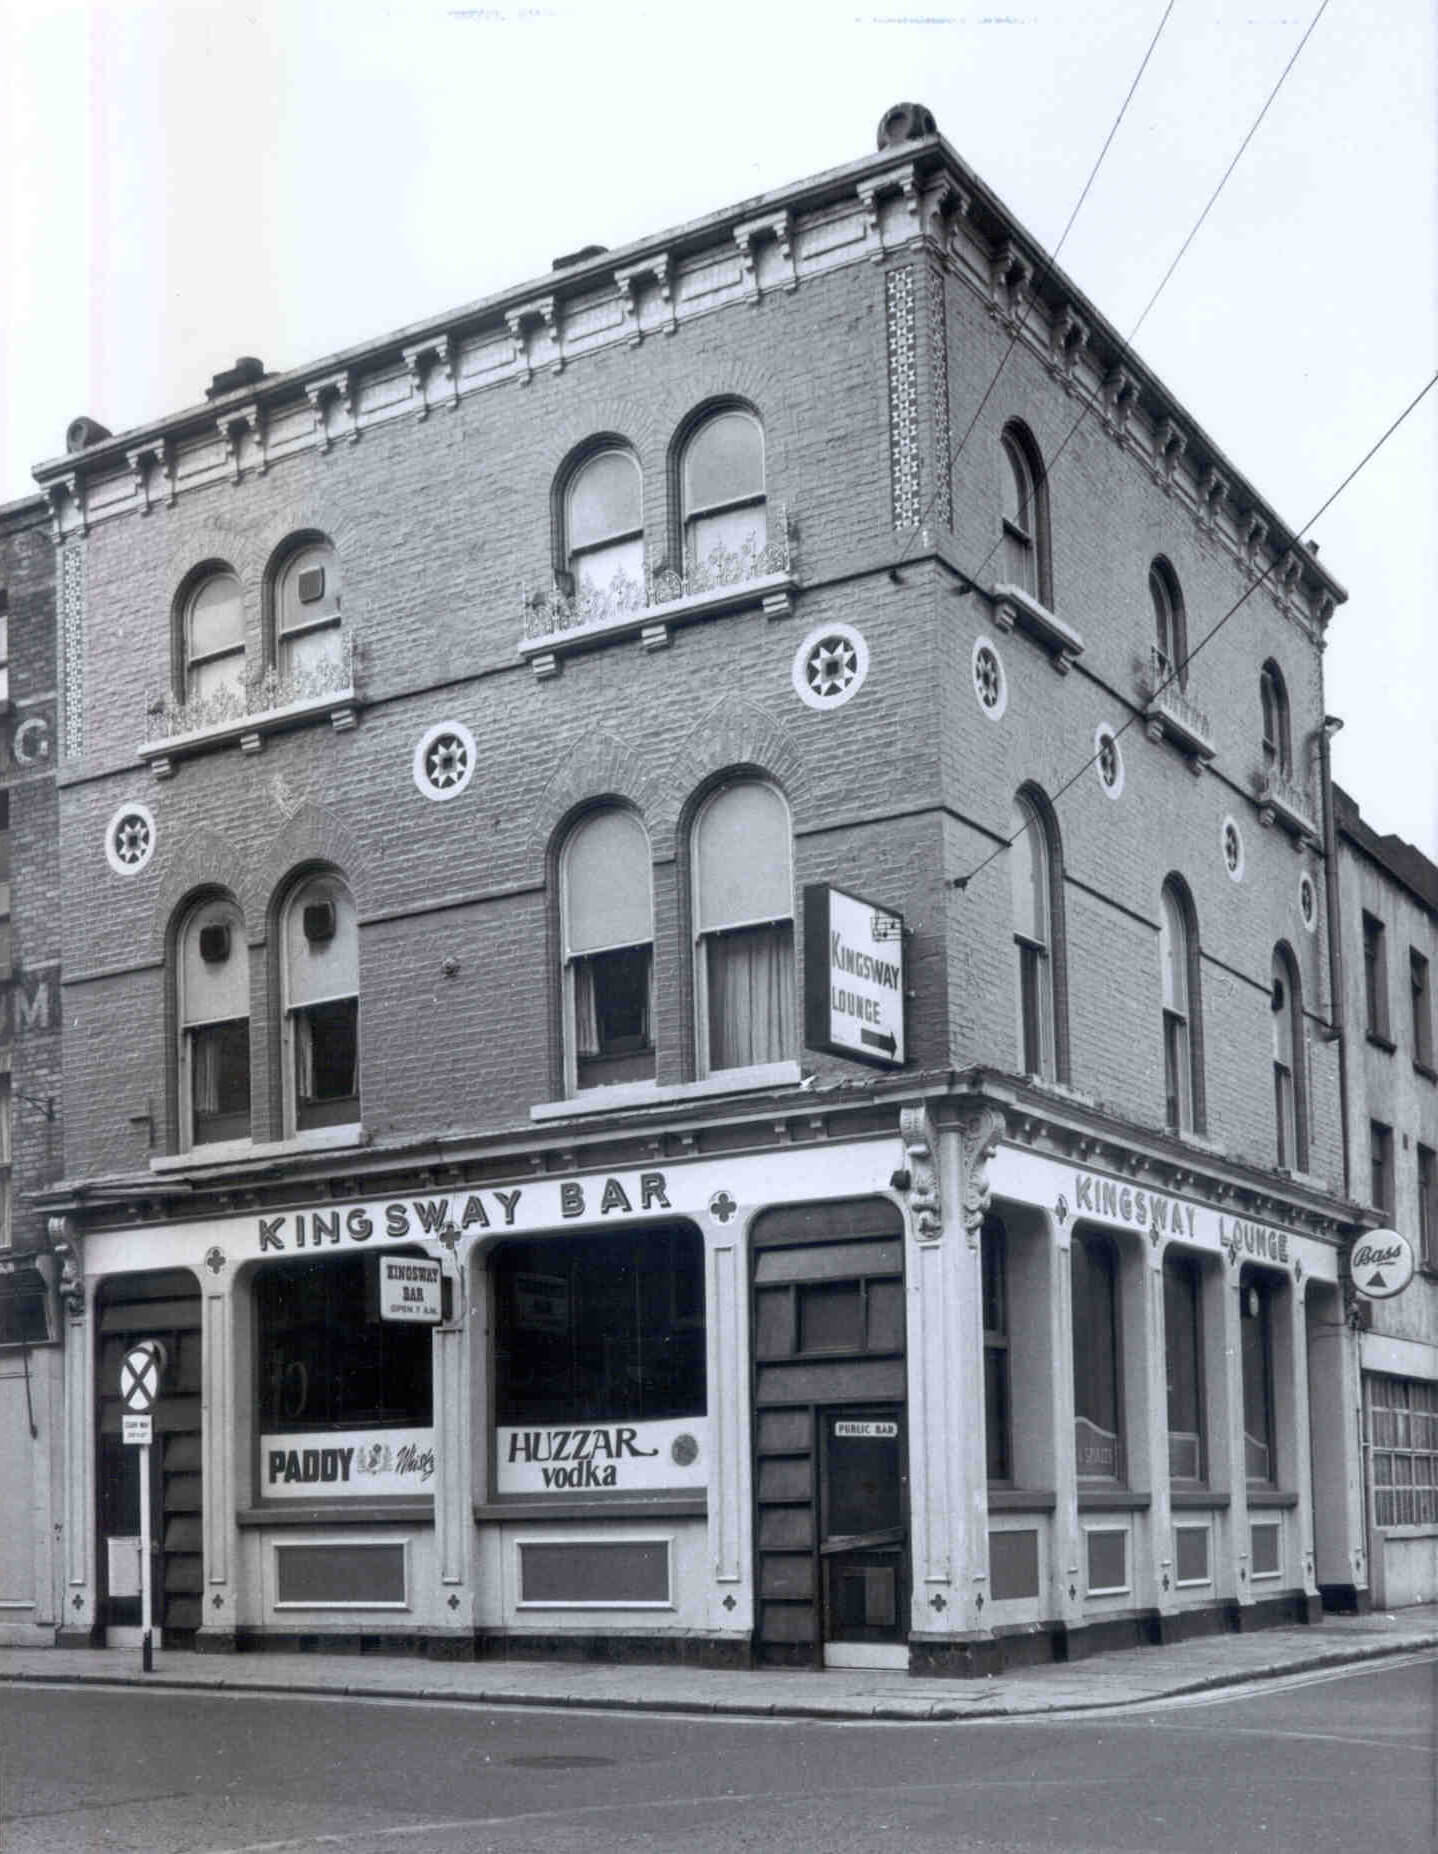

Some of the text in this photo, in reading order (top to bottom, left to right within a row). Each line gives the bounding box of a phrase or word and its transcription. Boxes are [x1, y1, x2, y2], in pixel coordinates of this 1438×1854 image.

[832, 930, 900, 991] KINGSWAY
[832, 986, 881, 1025] LOUNGE
[258, 1171, 671, 1252] KINGSWAY BAR
[1076, 1174, 1289, 1263] KINGSWAY LOUNGE
[387, 1264, 439, 1283] KINGSWAY
[1353, 1244, 1402, 1268] Bass
[402, 1286, 424, 1302] BAR
[508, 1428, 659, 1463] HUZZAR
[838, 1423, 895, 1435] PUBLIC BAR
[269, 1448, 354, 1484] PADDY
[542, 1460, 617, 1489] vodka
